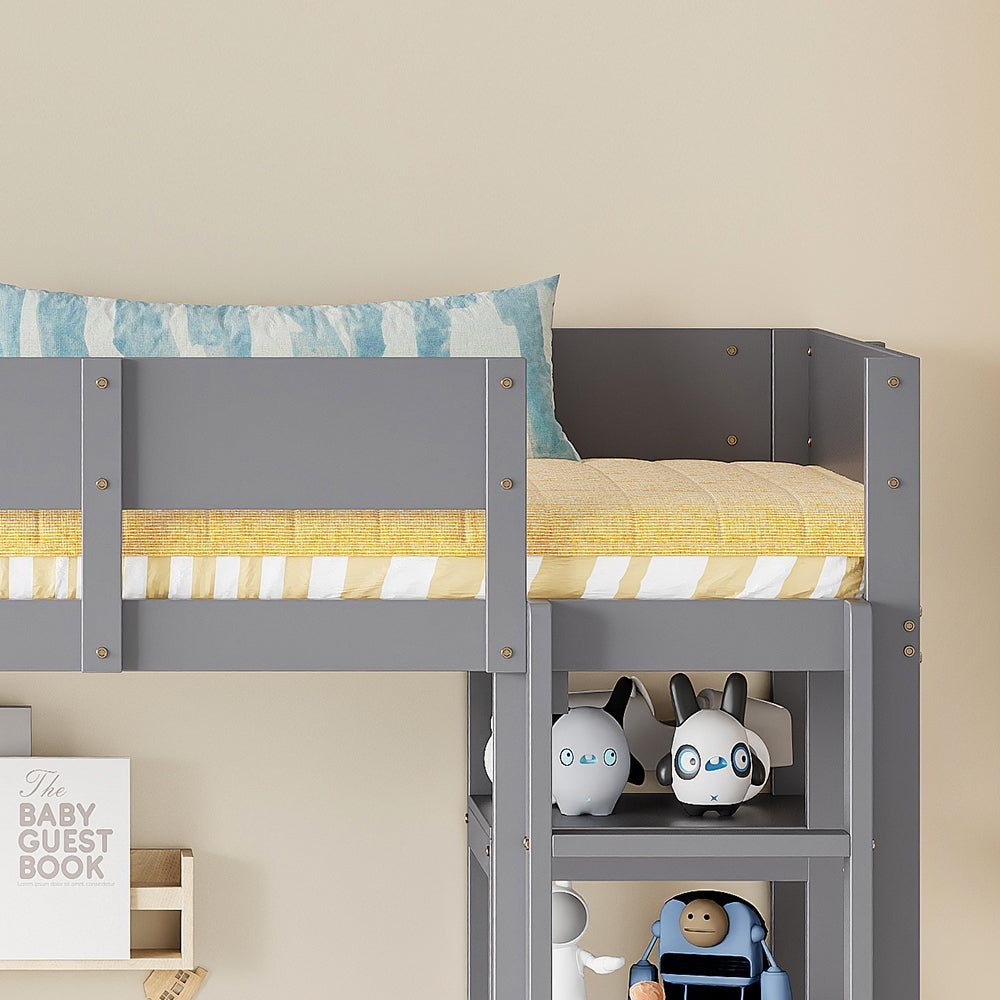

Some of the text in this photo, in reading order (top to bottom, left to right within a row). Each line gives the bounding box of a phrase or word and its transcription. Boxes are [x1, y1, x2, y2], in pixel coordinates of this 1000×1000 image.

[18, 768, 68, 798] The
[19, 802, 96, 827] BABY
[17, 828, 114, 853] GUEST
[19, 855, 105, 880] BOOK
